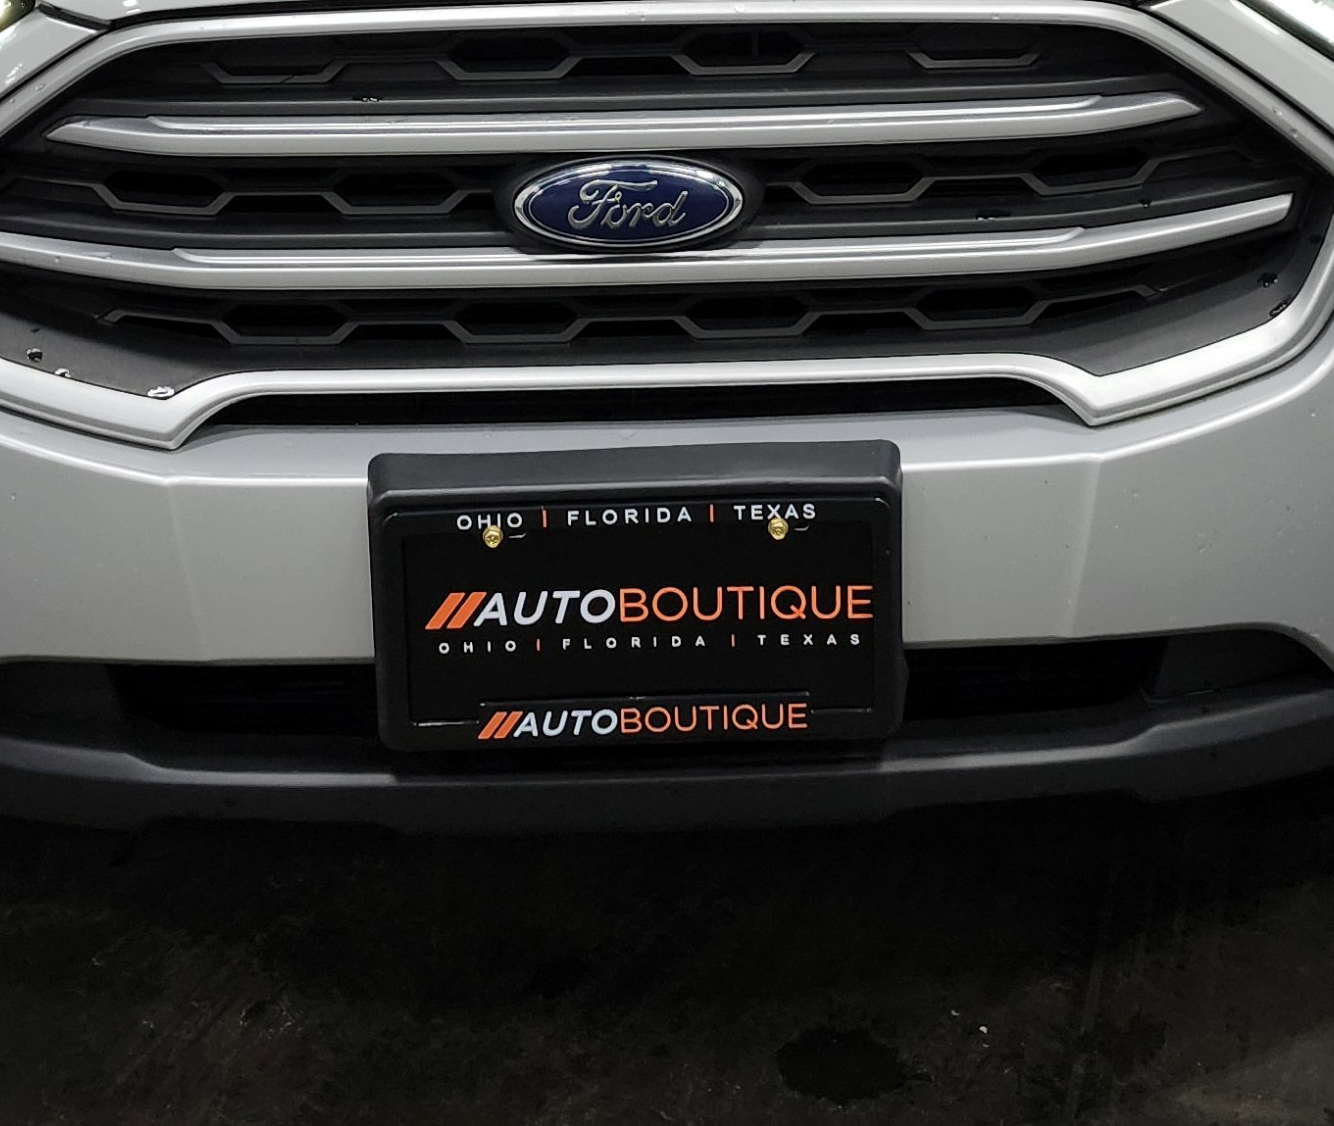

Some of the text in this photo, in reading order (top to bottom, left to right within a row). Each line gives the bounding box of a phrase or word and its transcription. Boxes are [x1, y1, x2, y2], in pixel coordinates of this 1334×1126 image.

[567, 179, 689, 230] Ford
[456, 503, 817, 530] OHIO FLORIDA TEXAS
[473, 585, 874, 628] AUTOBOUTIQUE
[438, 633, 860, 655] OHIO FLORIDA TEXAS
[515, 702, 808, 737] AUTOBOUTIQUE
